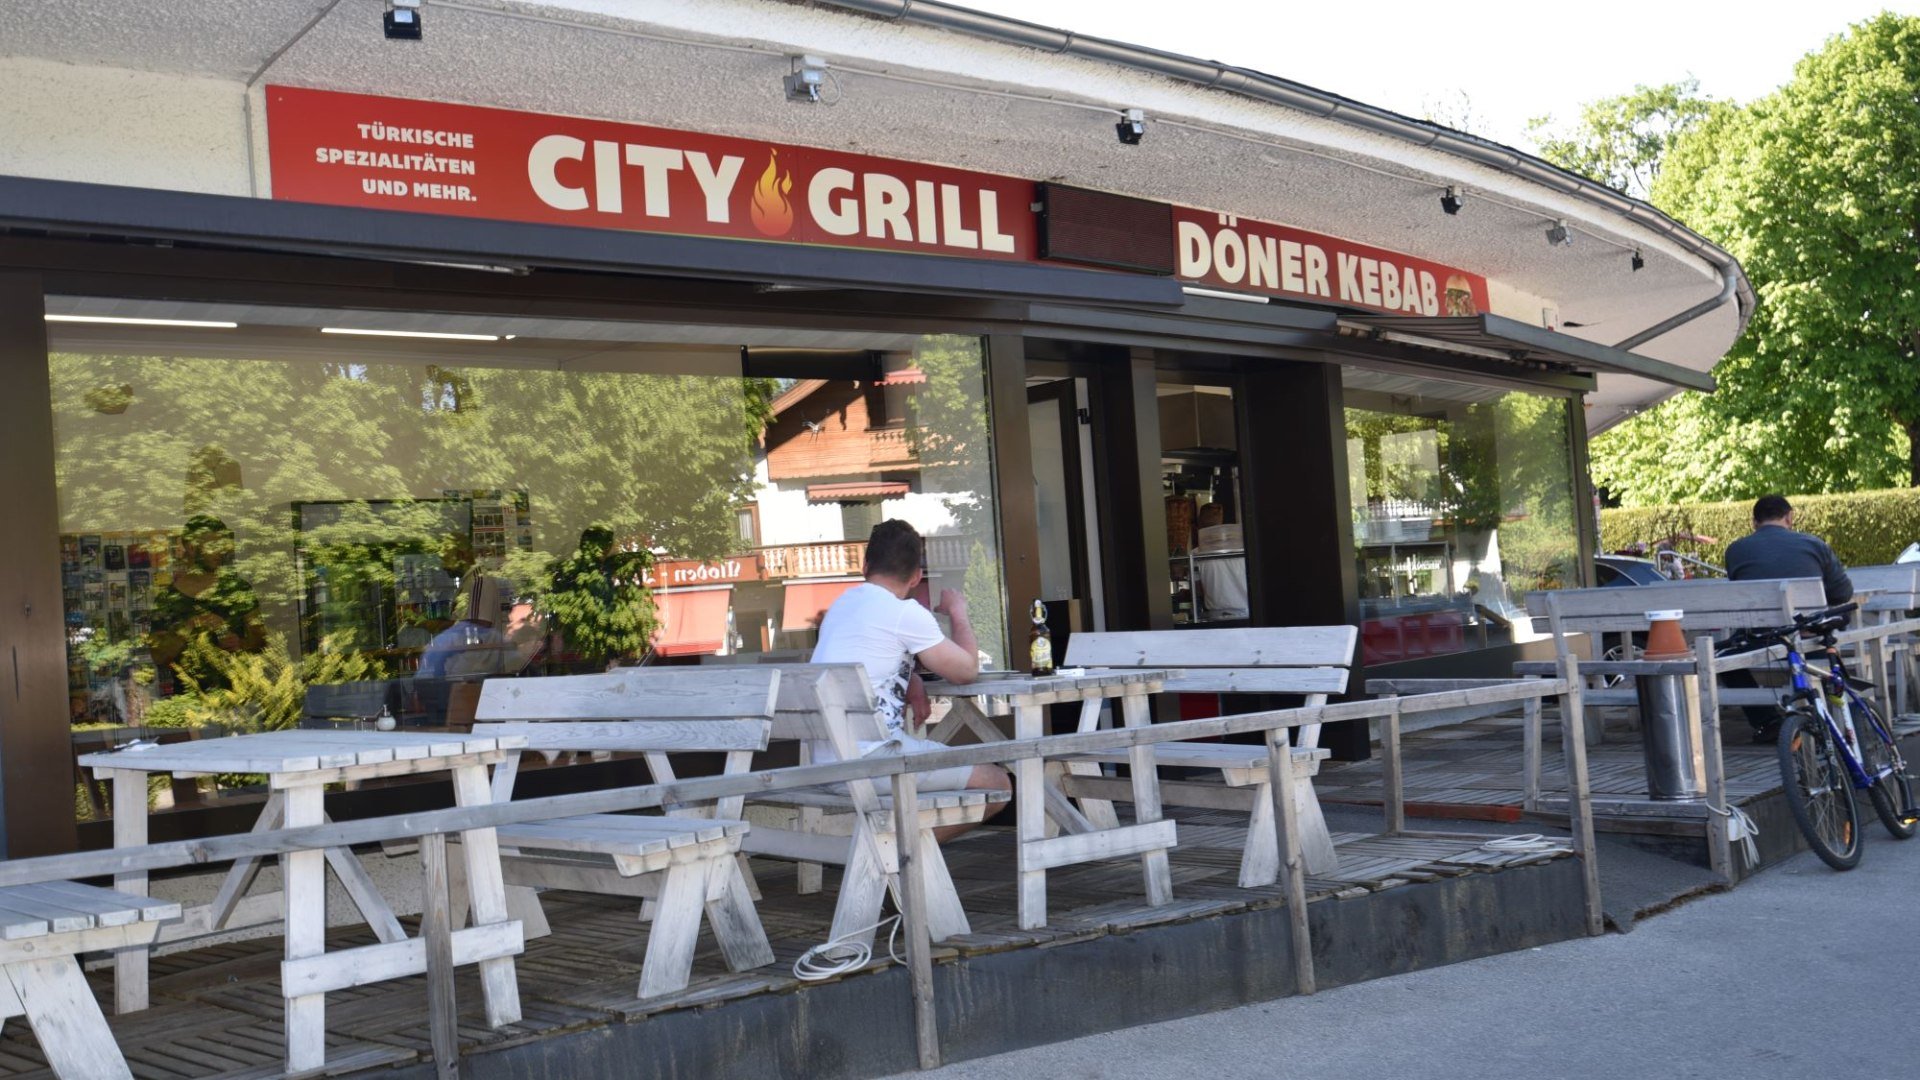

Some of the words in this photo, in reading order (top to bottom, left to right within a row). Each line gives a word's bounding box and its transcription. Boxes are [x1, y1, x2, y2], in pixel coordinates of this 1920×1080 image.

[357, 122, 474, 148] TÜRKISCHE
[315, 147, 475, 175] SPEZIALITÄTEN
[362, 178, 408, 196] UND
[413, 182, 477, 202] MEHR.
[528, 134, 745, 223] CITY
[807, 167, 1015, 253] GRILL
[1178, 214, 1331, 297] DÖNER
[1336, 252, 1440, 317] KEBAB
